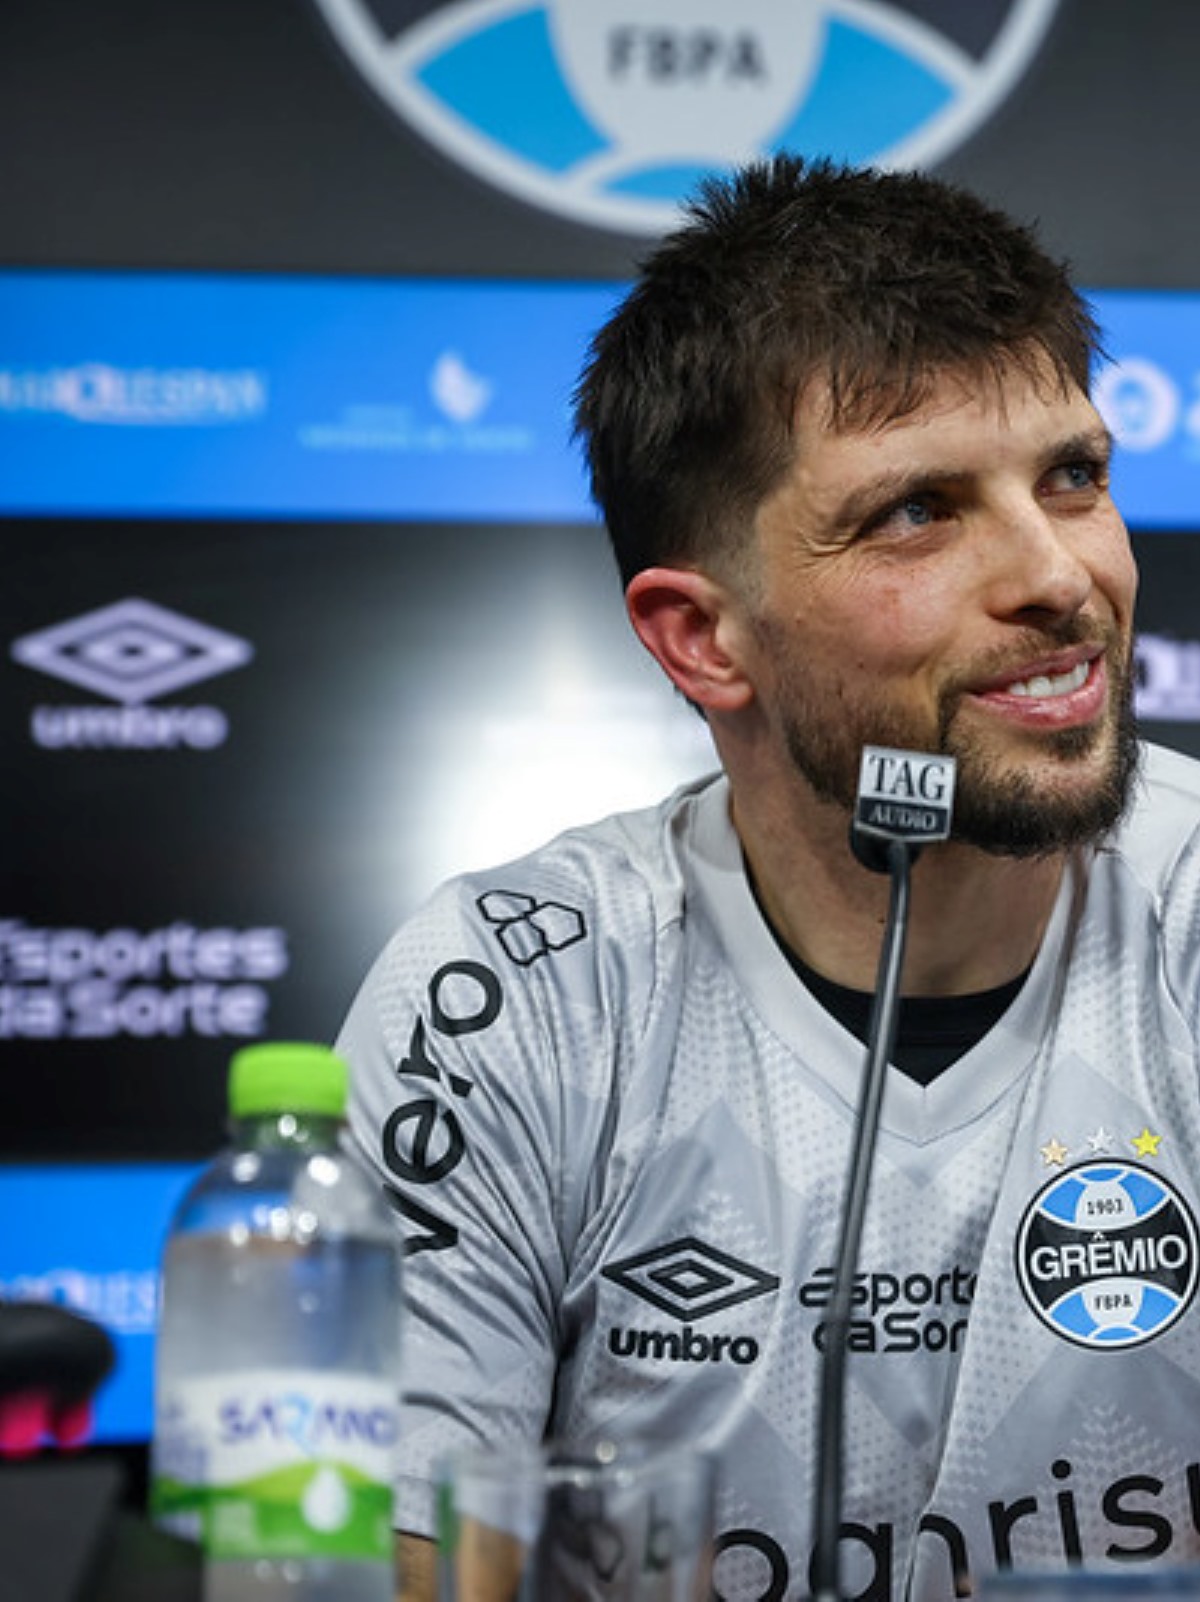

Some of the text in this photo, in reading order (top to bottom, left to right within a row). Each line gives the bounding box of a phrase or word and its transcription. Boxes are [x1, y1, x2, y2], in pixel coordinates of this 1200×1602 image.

[606, 28, 768, 86] FBPA
[31, 704, 229, 750] umbro
[868, 755, 946, 801] TAG
[868, 804, 937, 831] AUDIO
[382, 960, 503, 1257] vero
[1086, 1198, 1125, 1215] 1903
[1029, 1231, 1188, 1281] GRÊMIO
[799, 1264, 977, 1316] Esport
[1093, 1294, 1133, 1311] FBPA
[608, 1326, 760, 1366] umbro
